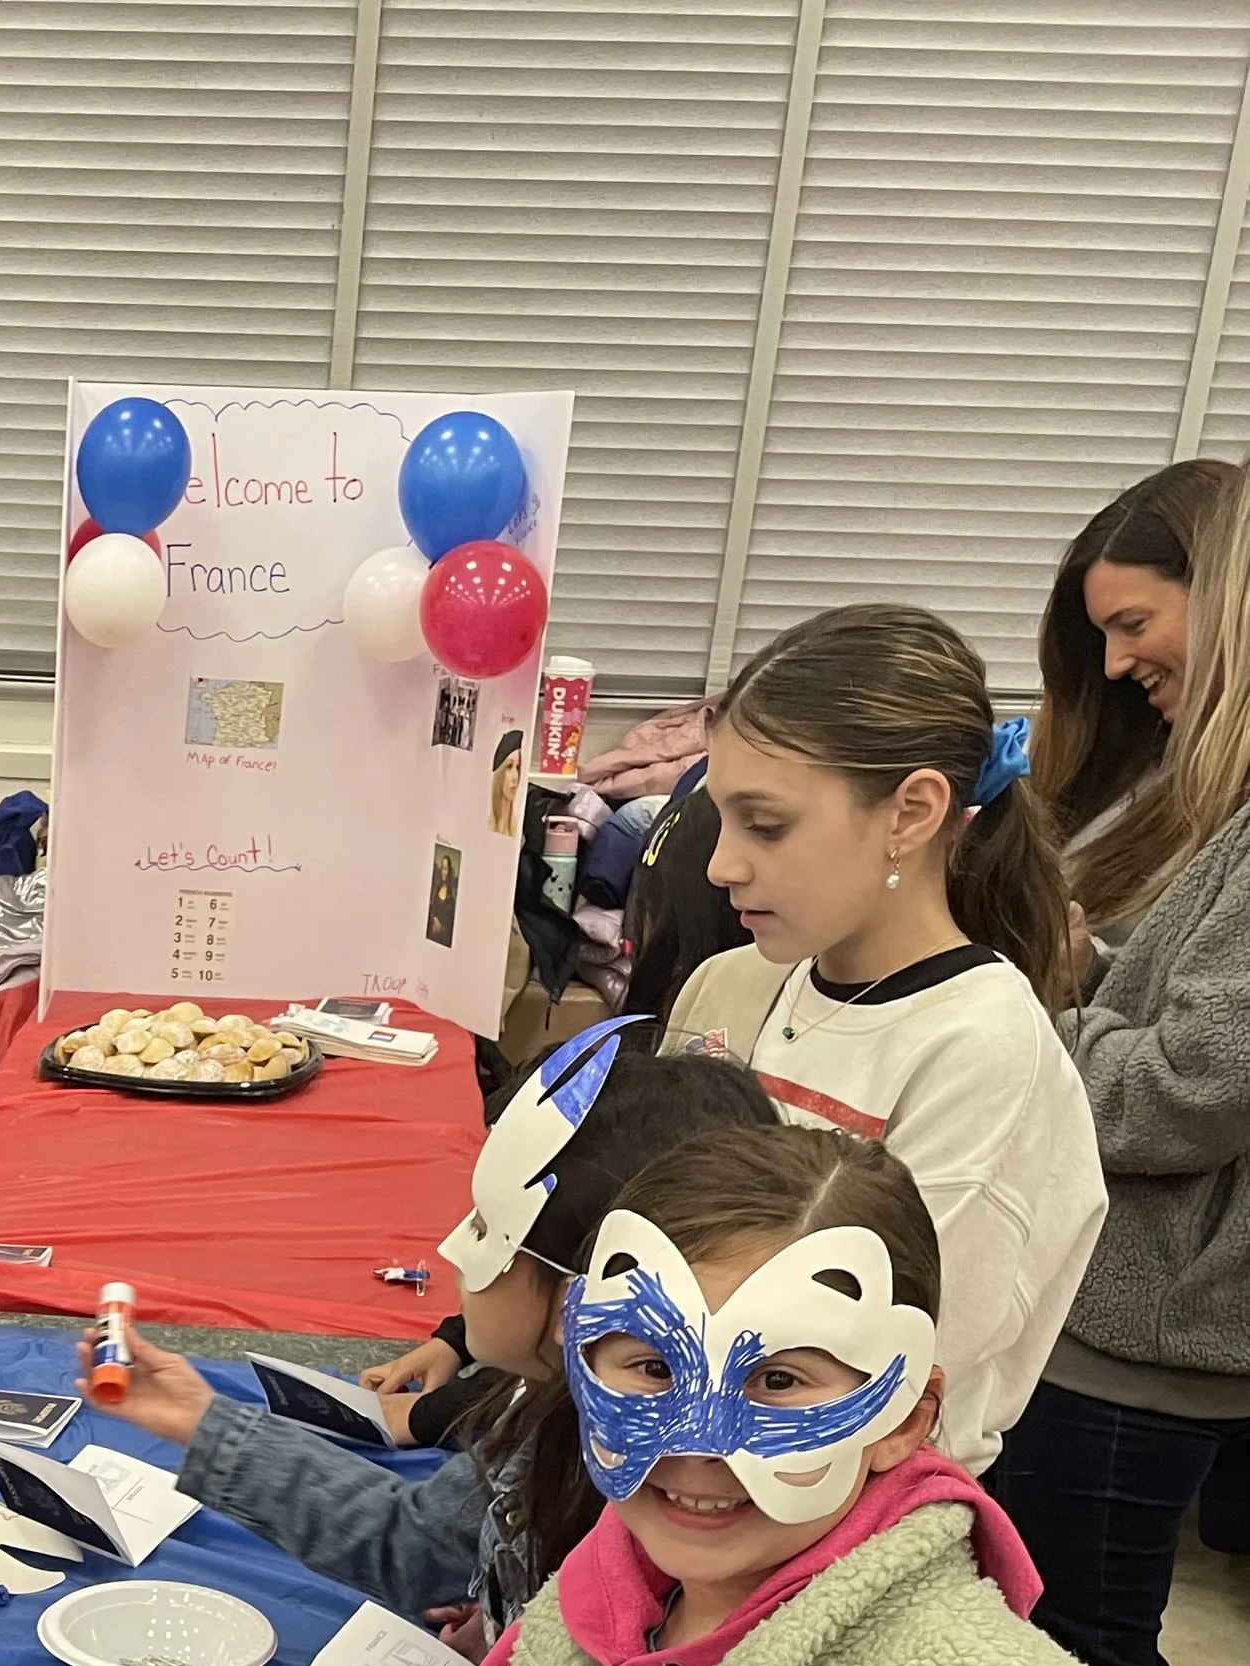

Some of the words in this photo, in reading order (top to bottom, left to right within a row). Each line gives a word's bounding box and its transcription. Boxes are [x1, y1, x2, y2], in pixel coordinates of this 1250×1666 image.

[185, 432, 313, 508] elcome
[324, 431, 364, 503] to
[166, 543, 291, 598] France
[548, 686, 568, 760] DUNKIN'
[148, 841, 195, 866] Let's
[177, 897, 183, 908] 1
[209, 898, 217, 910] 6
[175, 915, 183, 927] 2
[208, 916, 216, 929] 7
[173, 932, 182, 943] 3
[206, 934, 214, 945] 8
[172, 949, 180, 960] 4
[205, 950, 213, 962] 9
[170, 968, 179, 979] 5
[199, 969, 213, 981] 10
